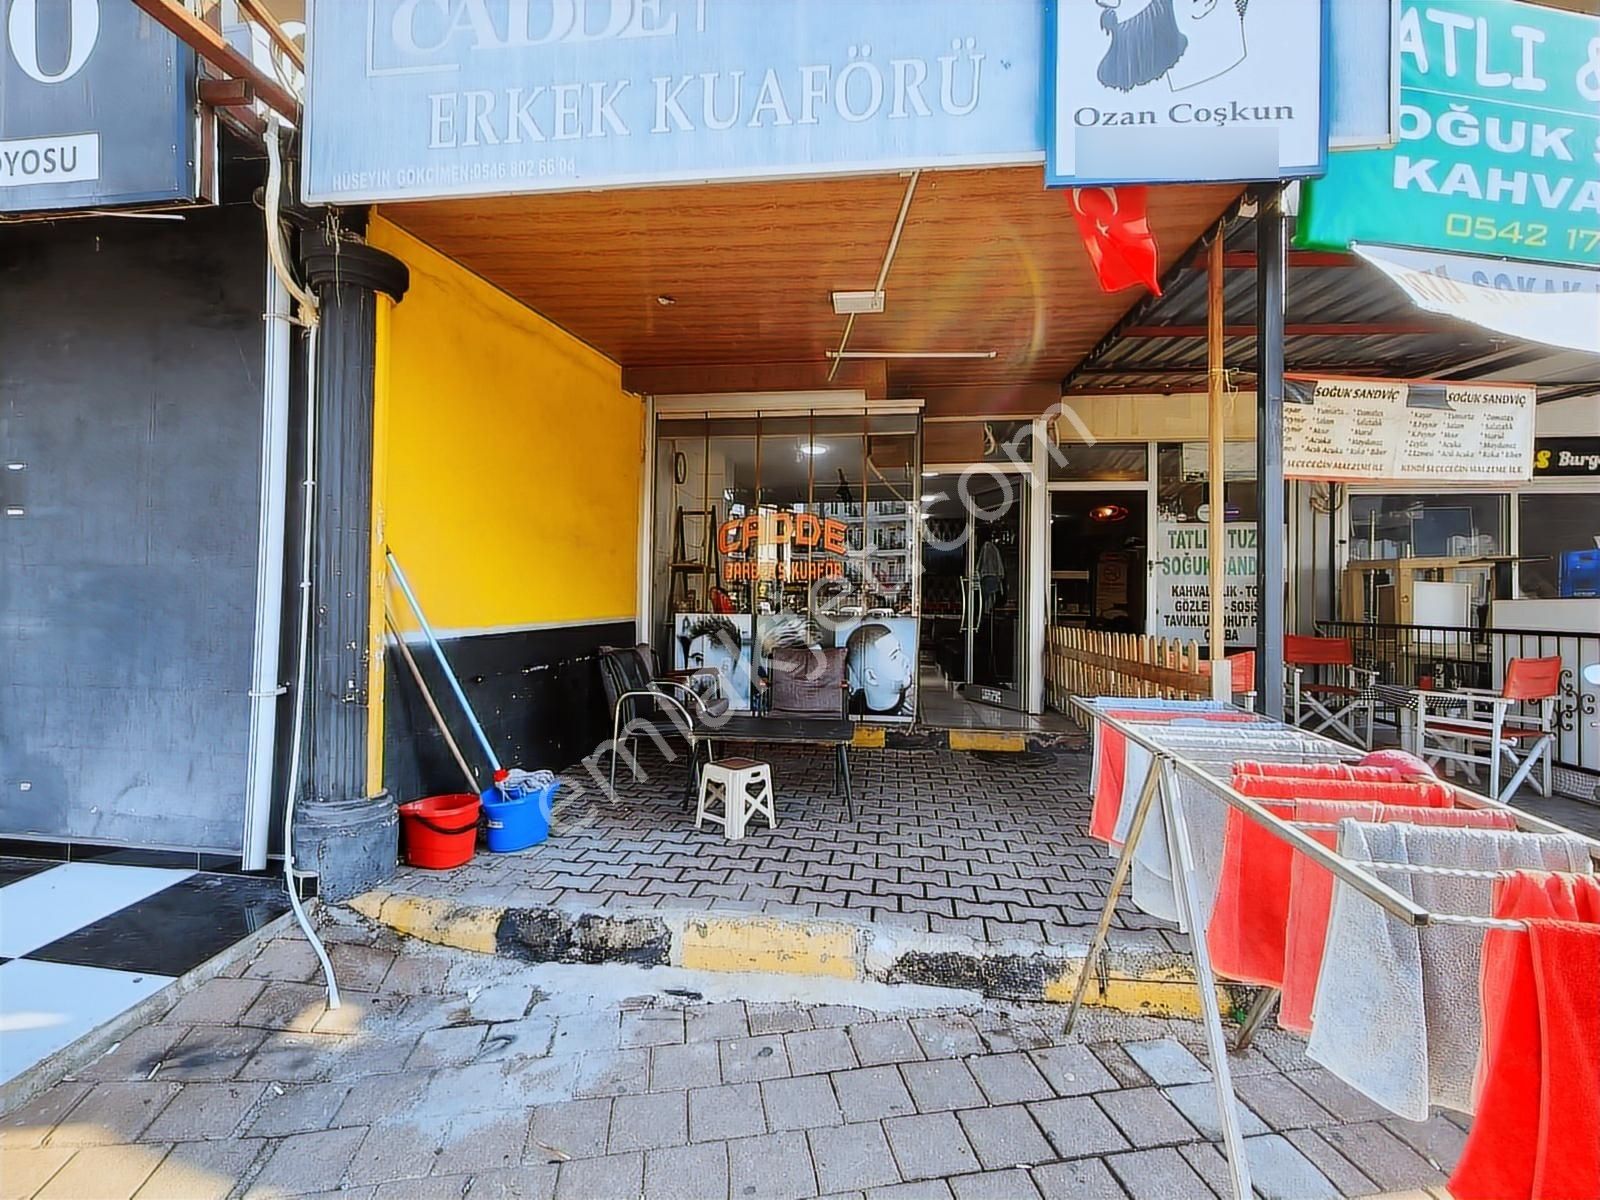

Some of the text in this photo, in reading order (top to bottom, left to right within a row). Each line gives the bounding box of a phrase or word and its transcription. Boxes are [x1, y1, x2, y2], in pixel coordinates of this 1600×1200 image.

[427, 37, 986, 150] ERKEK KUAFÖRÜ
[1074, 100, 1295, 127] Ozan Coşkun
[0, 146, 78, 177] YOSU
[1446, 212, 1549, 247] 0542
[1314, 385, 1400, 403] SOĞUK SANDVİÇ
[1448, 390, 1527, 408] SOĞUK SANDVİÇ
[1535, 449, 1552, 470] S
[718, 512, 849, 556] CADDE
[1167, 529, 1208, 549] TATLI
[1224, 556, 1257, 576] AND
[1164, 615, 1210, 627] TAVUKLU
